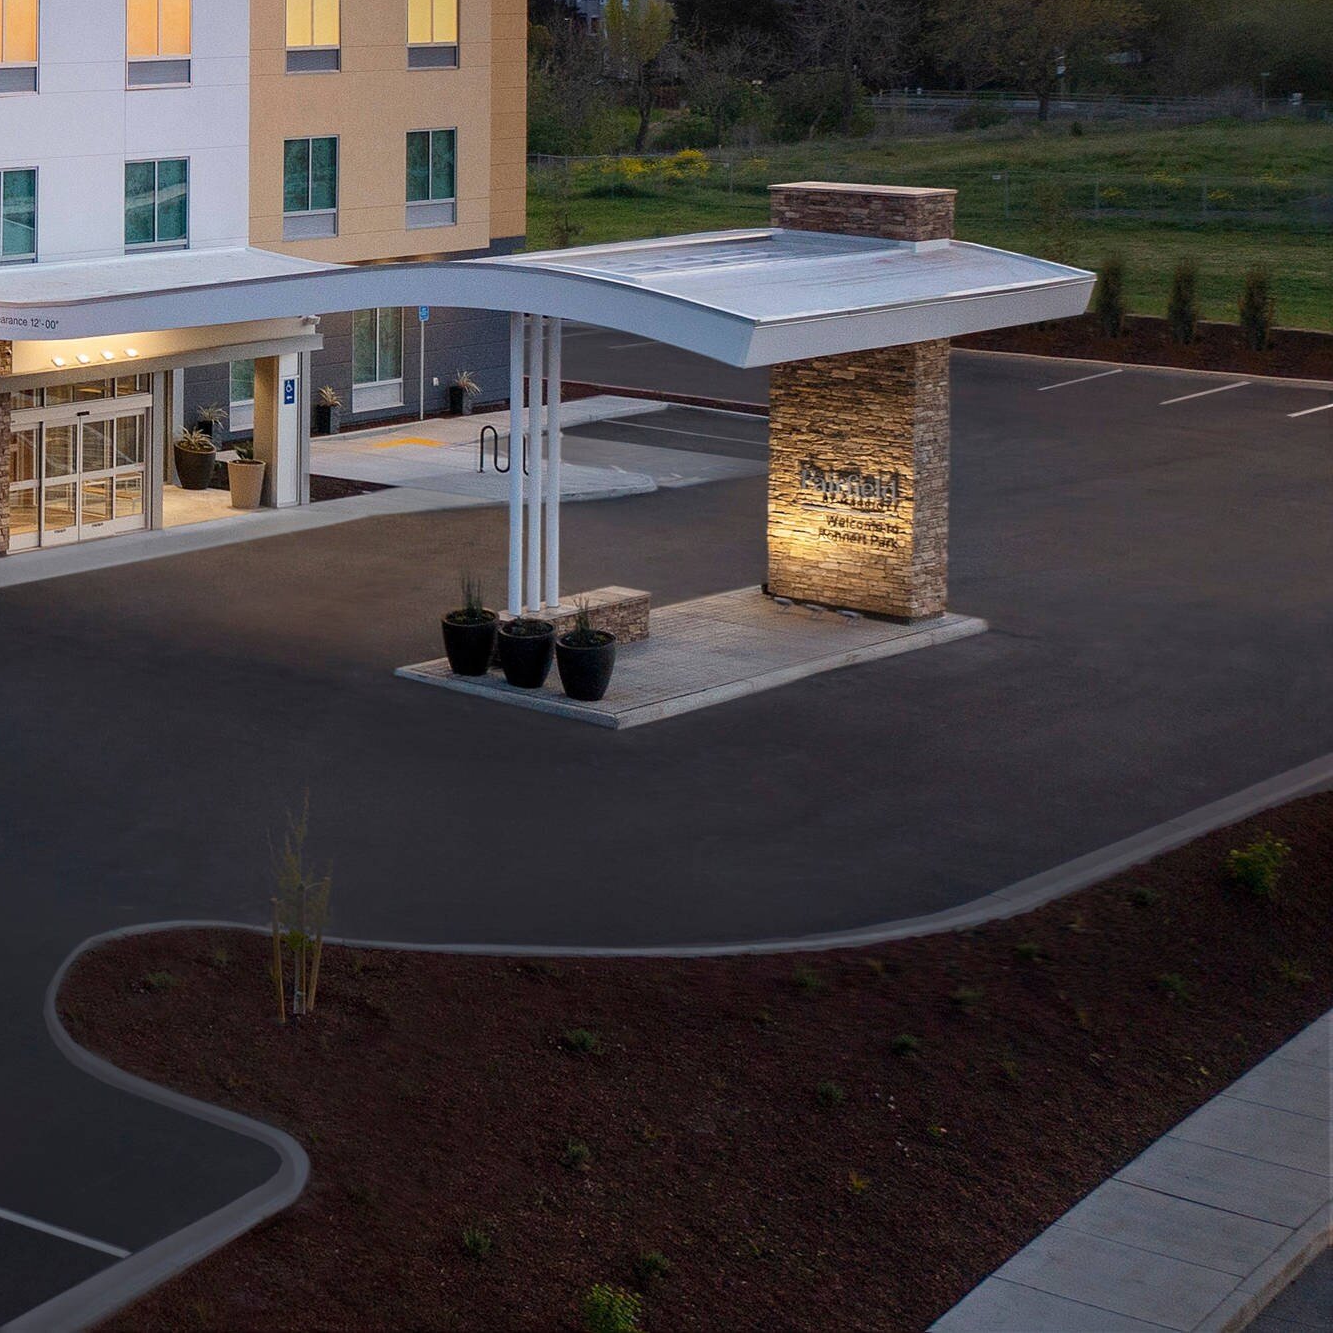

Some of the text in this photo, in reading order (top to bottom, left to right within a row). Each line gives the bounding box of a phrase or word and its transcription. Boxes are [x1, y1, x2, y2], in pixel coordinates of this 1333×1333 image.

[800, 468, 897, 505] Fairfield
[826, 515, 884, 532] Welcome
[870, 534, 900, 549] Park
